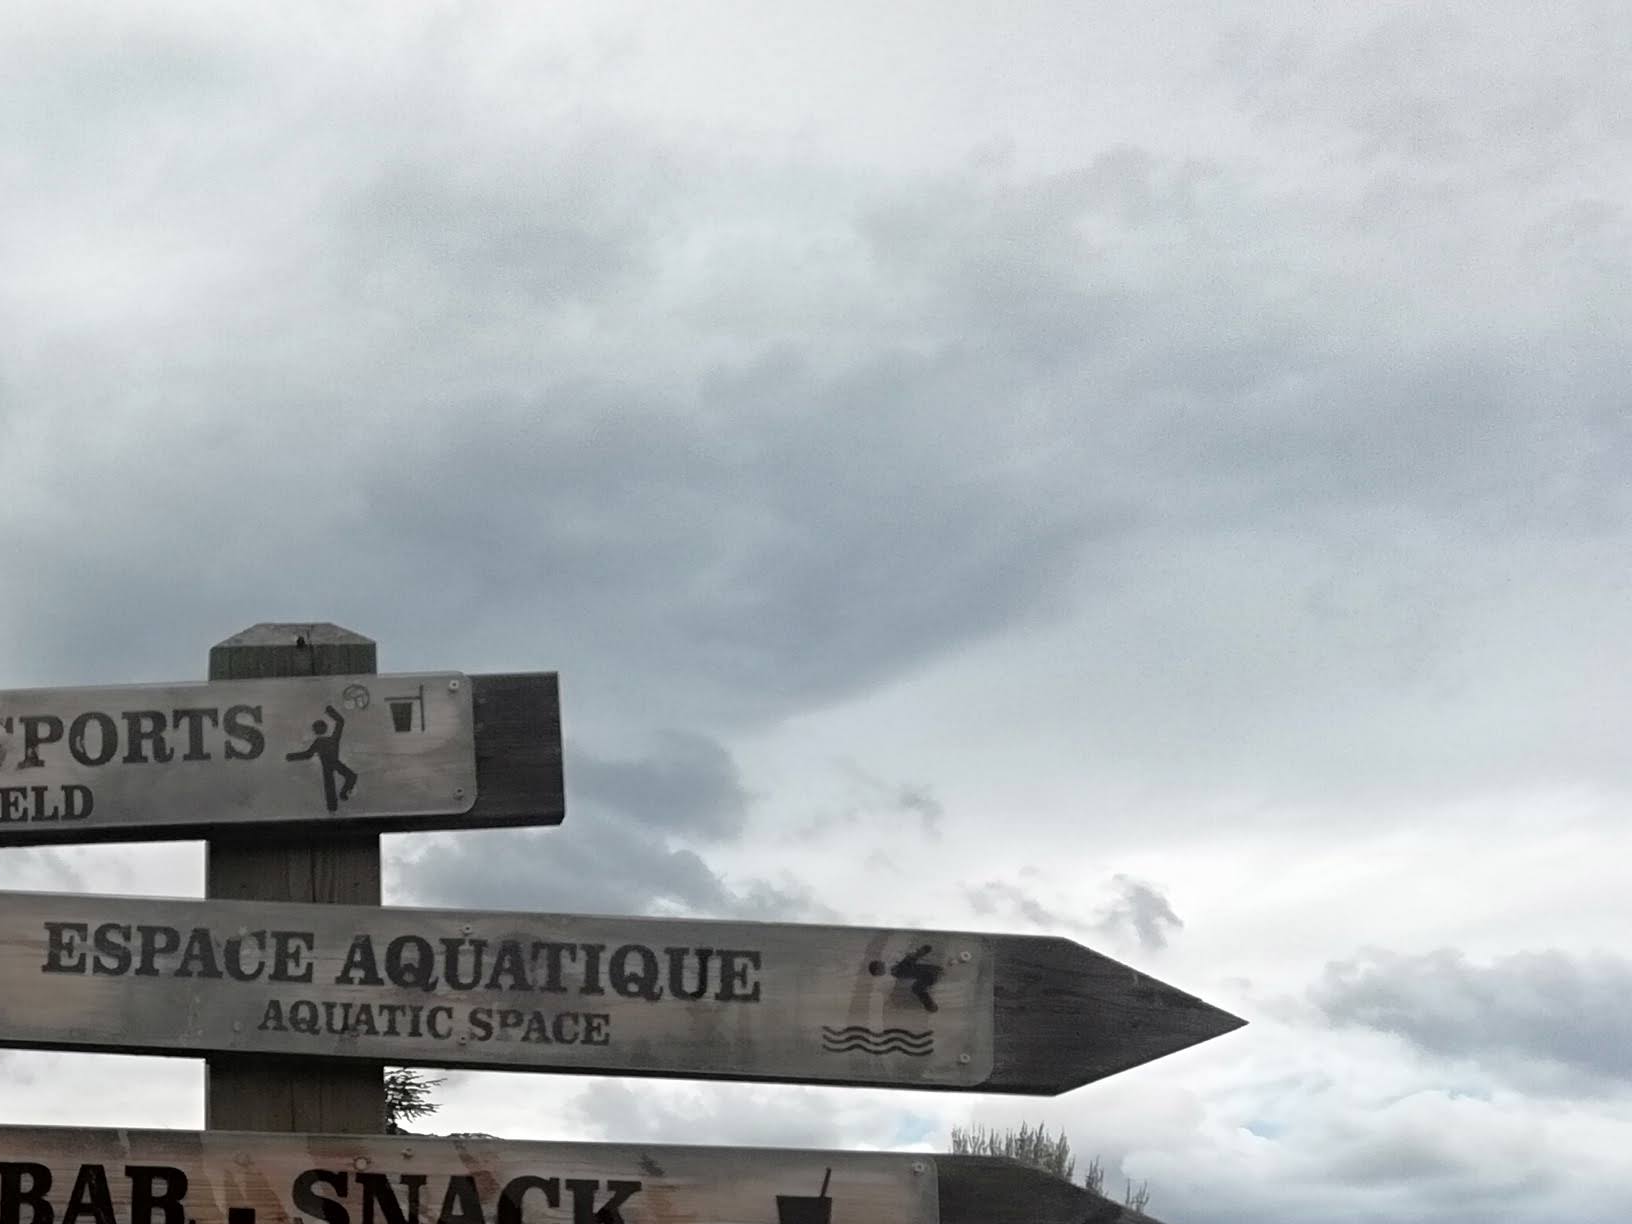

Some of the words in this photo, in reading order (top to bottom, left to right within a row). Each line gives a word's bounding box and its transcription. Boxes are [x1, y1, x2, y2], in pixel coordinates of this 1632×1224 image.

[41, 921, 315, 985] ESPACE
[335, 933, 763, 1004] AQUATIQUE
[257, 1000, 454, 1042] AQUATIC
[468, 1006, 612, 1047] SPACE
